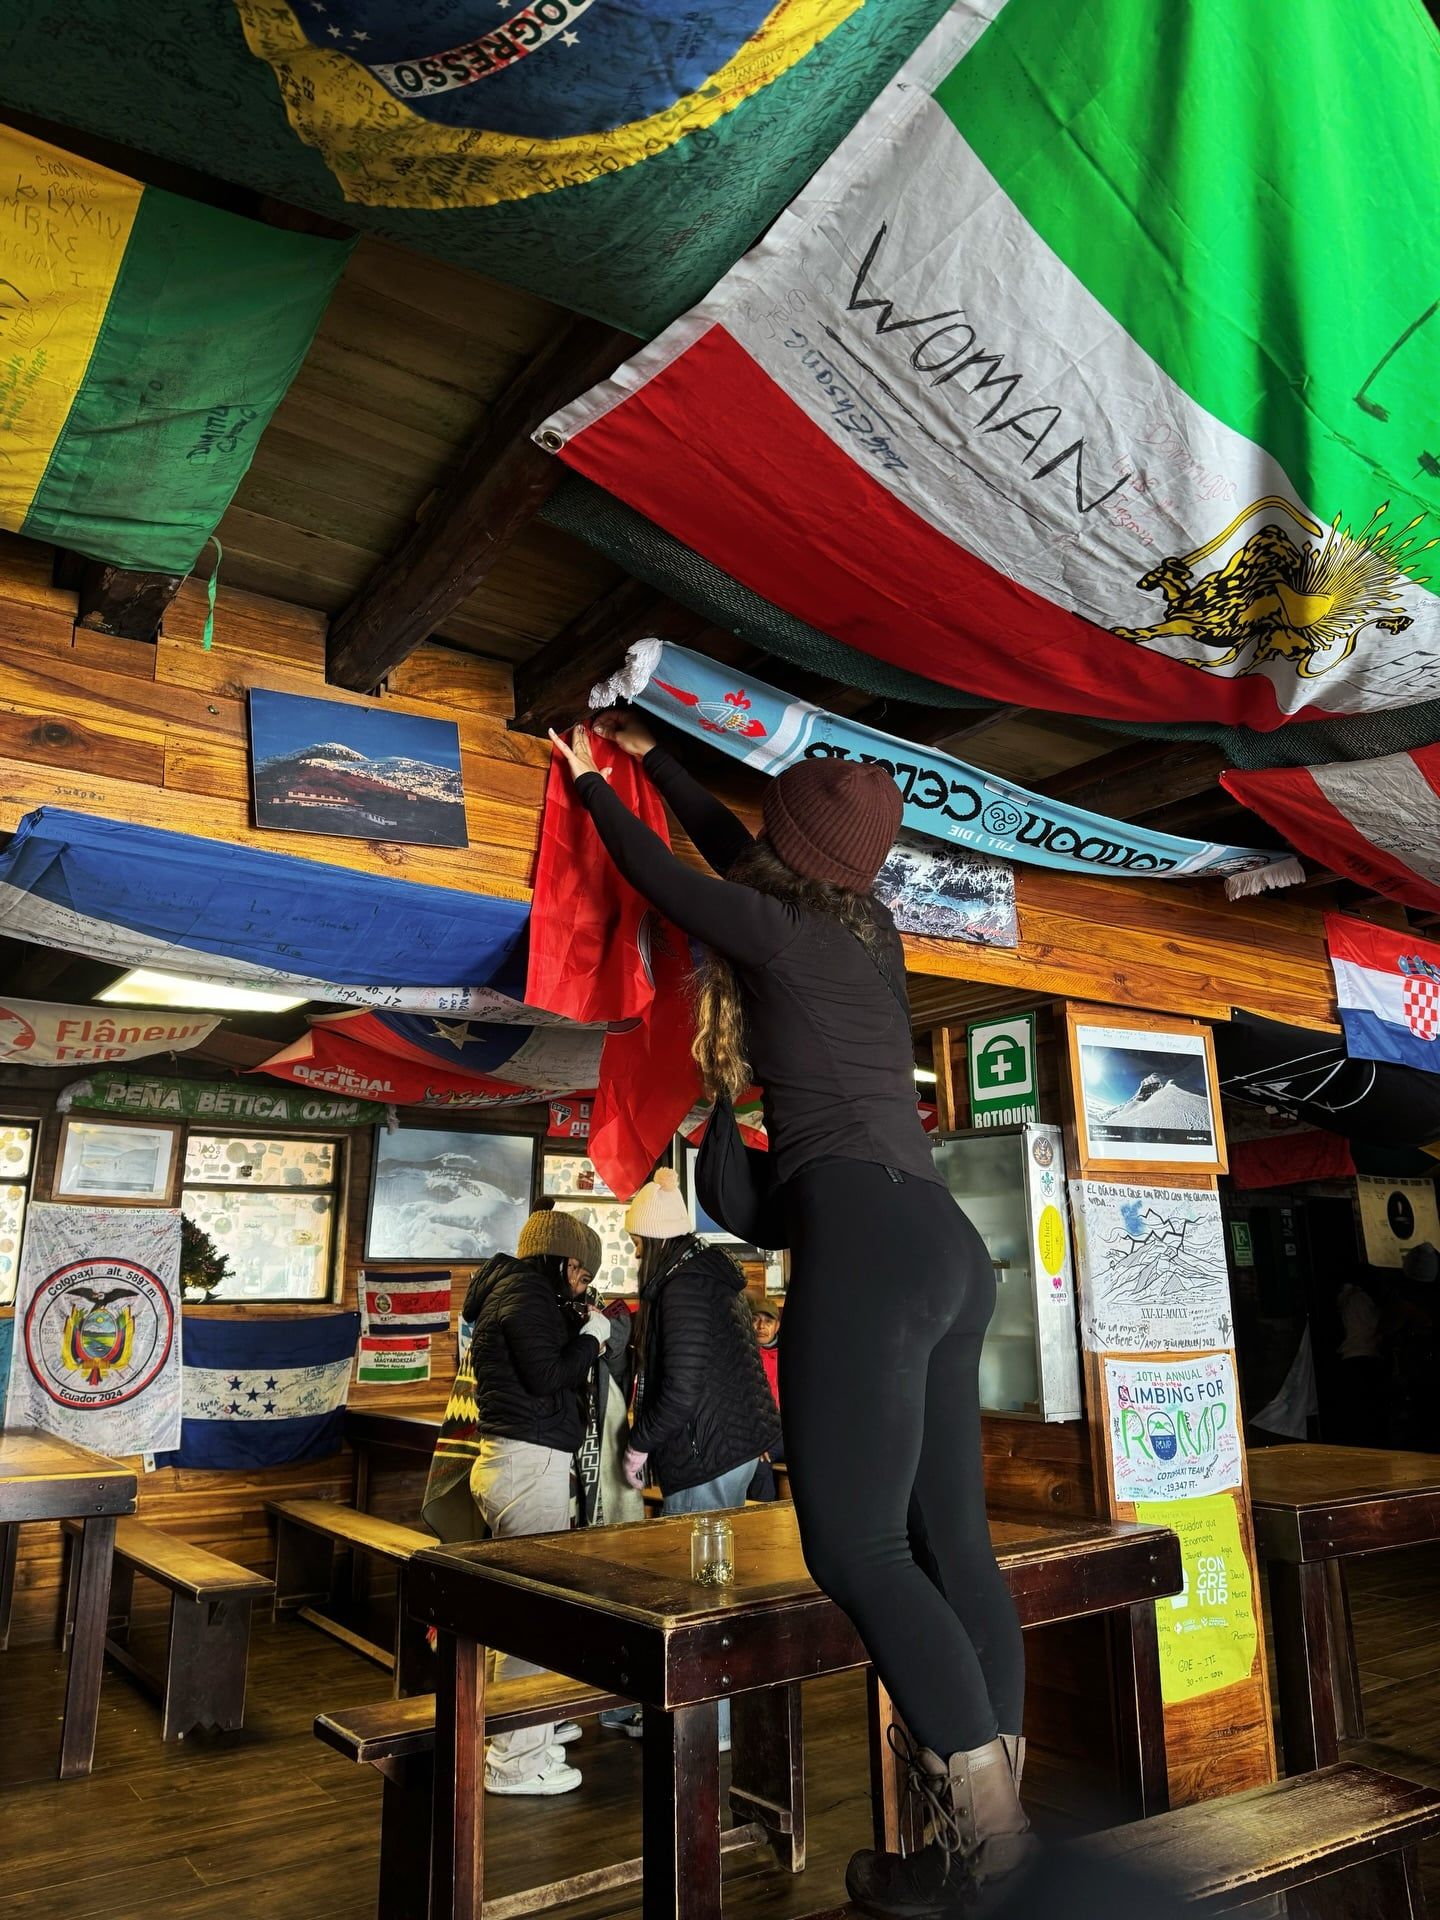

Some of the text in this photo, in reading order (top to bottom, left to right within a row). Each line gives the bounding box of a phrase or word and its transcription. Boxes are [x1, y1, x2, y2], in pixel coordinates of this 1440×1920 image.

[393, 0, 586, 93] OGRESSO
[847, 220, 1132, 513] WOMAN
[949, 825, 974, 842] DIE
[981, 836, 1015, 854] TILL
[56, 1018, 208, 1043] Flâneur
[293, 1065, 395, 1092] OFFICIAL
[336, 1064, 355, 1075] THE
[104, 1081, 183, 1111] PEÑA
[196, 1086, 290, 1120] BÉTICA
[301, 1100, 359, 1121] OJM
[48, 1267, 157, 1298] Cotopaxi alt. 5897 m
[1136, 1368, 1203, 1382] 10TH ANNUAL
[59, 1388, 123, 1403] Ecuador 2024
[1118, 1379, 1224, 1404] CLIMBING FOR
[1197, 1556, 1226, 1572] CON
[1197, 1572, 1228, 1588] GRE
[1196, 1588, 1228, 1606] TUR
